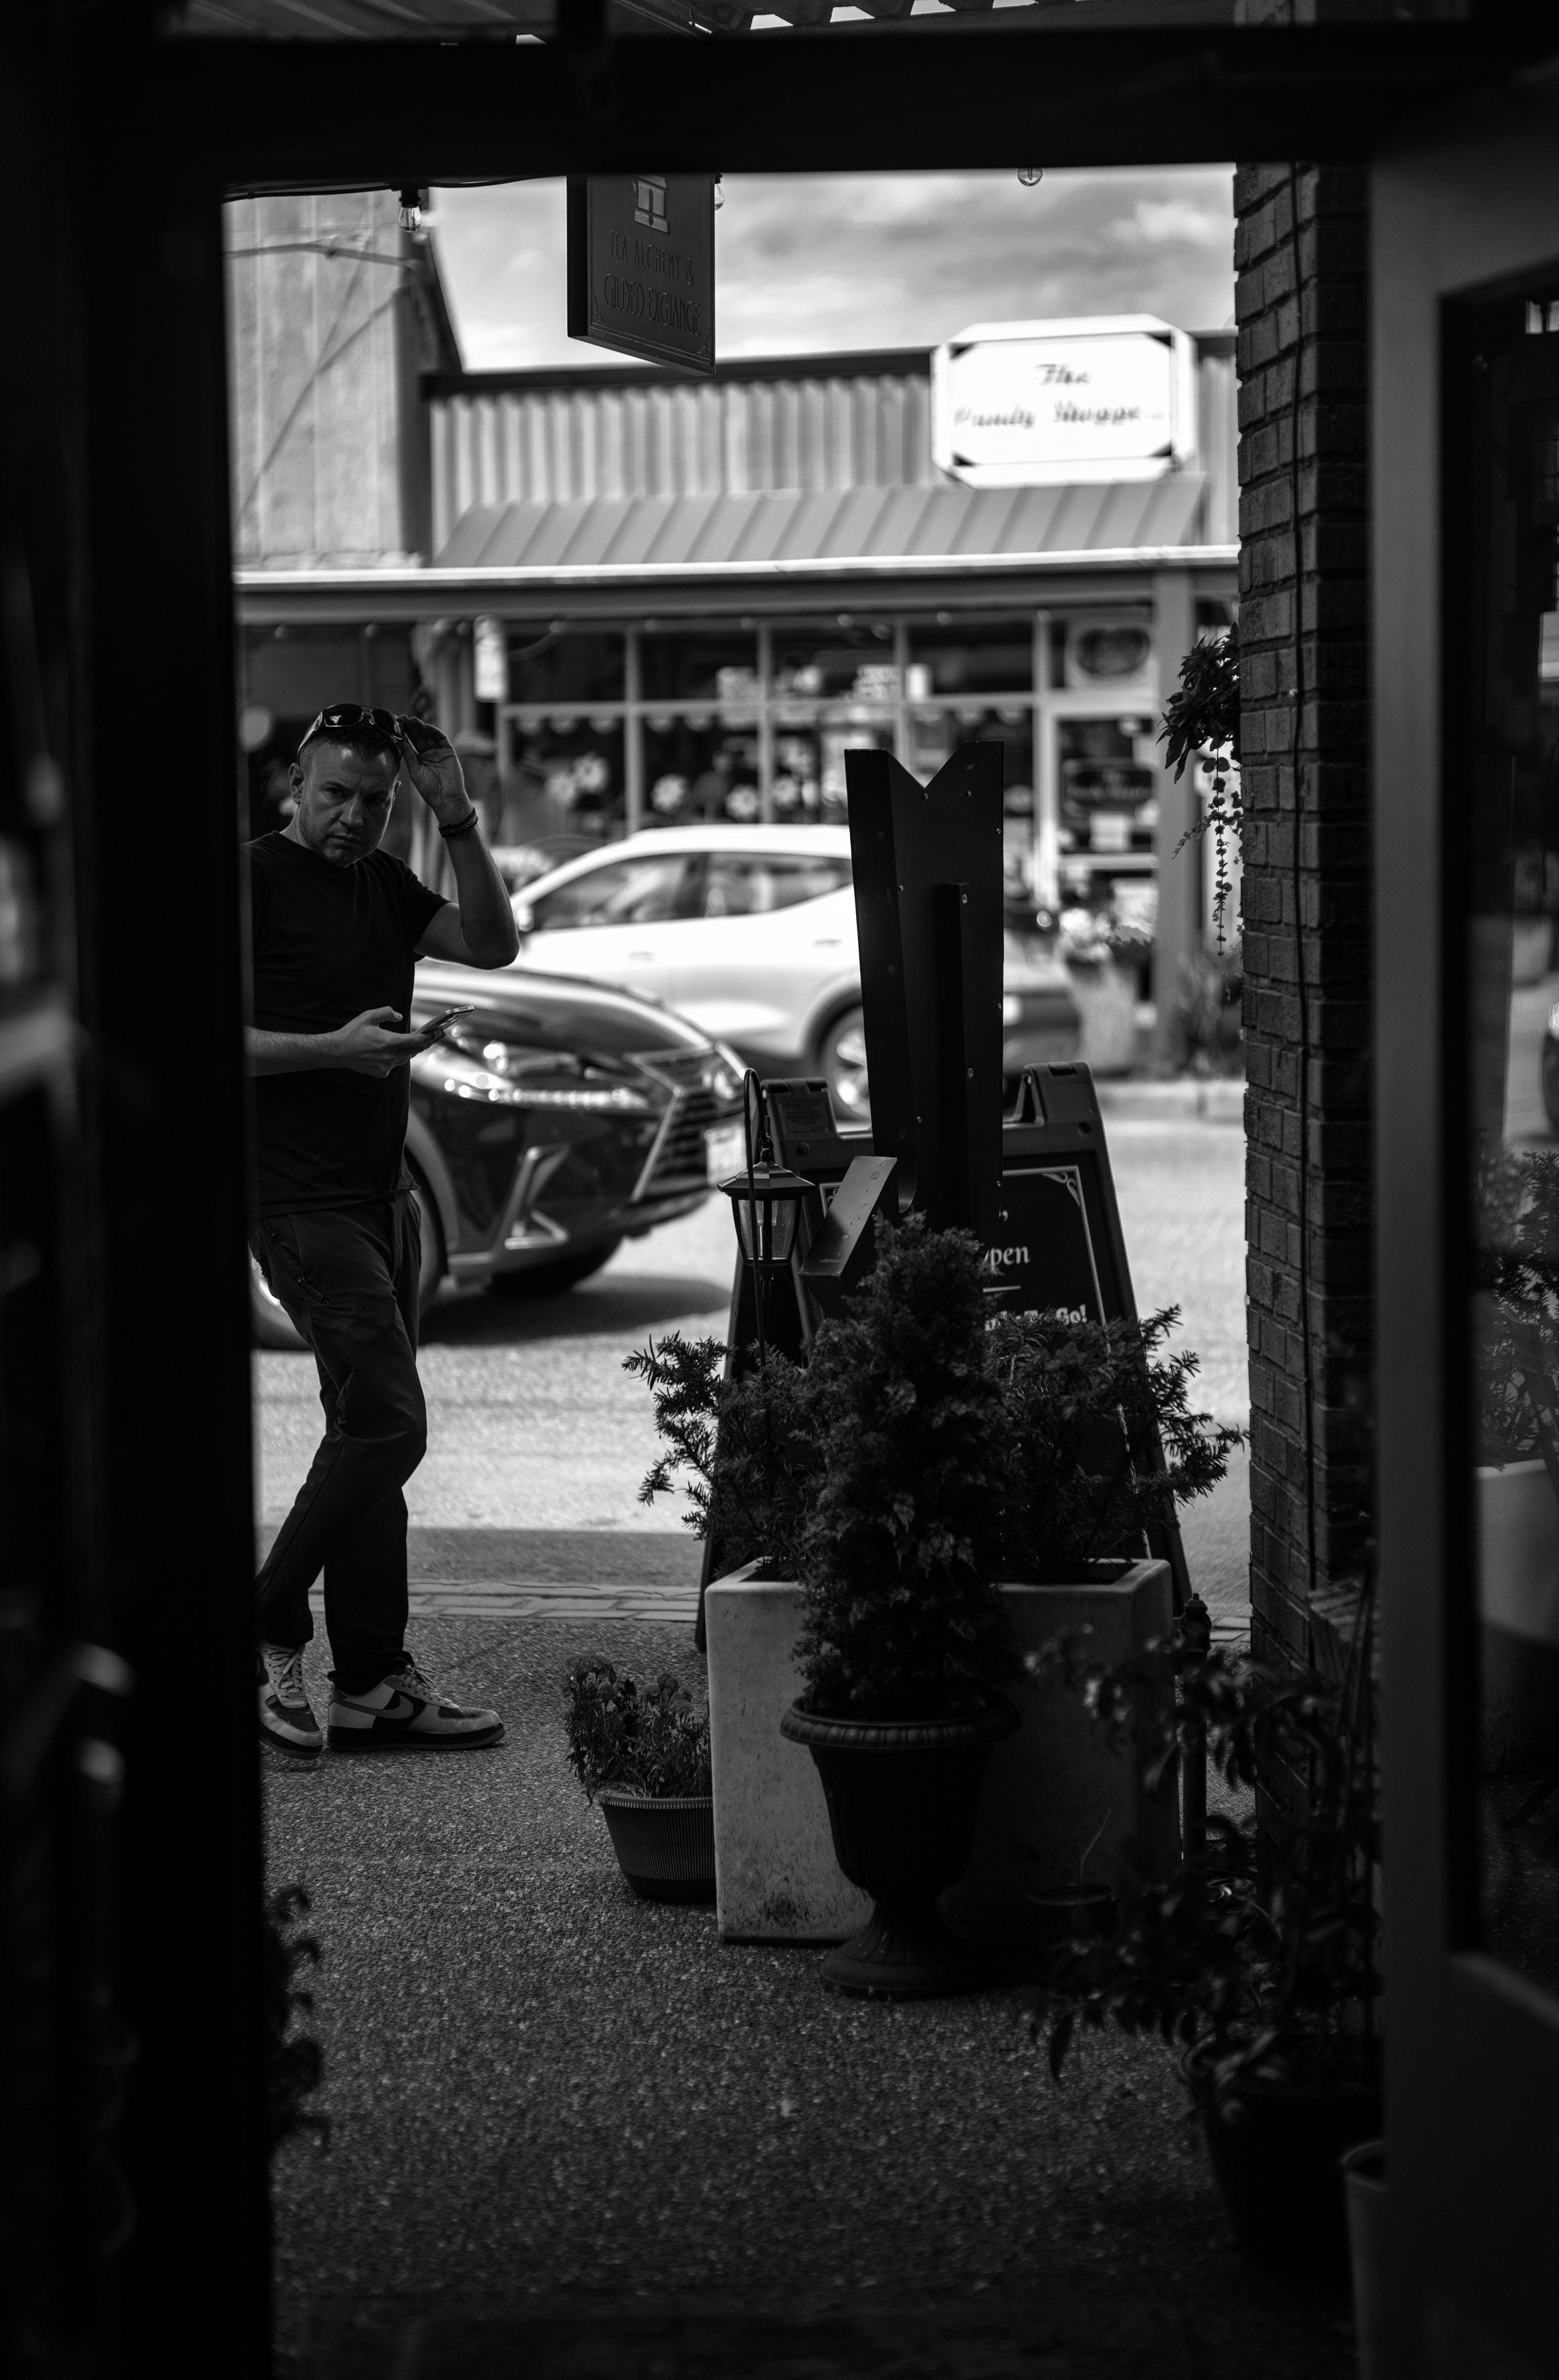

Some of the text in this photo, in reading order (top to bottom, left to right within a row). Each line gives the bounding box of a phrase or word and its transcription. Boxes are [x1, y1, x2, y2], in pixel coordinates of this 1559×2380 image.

[609, 229, 695, 286] TEA ALCHEMY &
[603, 273, 645, 316] GILDED
[984, 1245, 1031, 1271] pen
